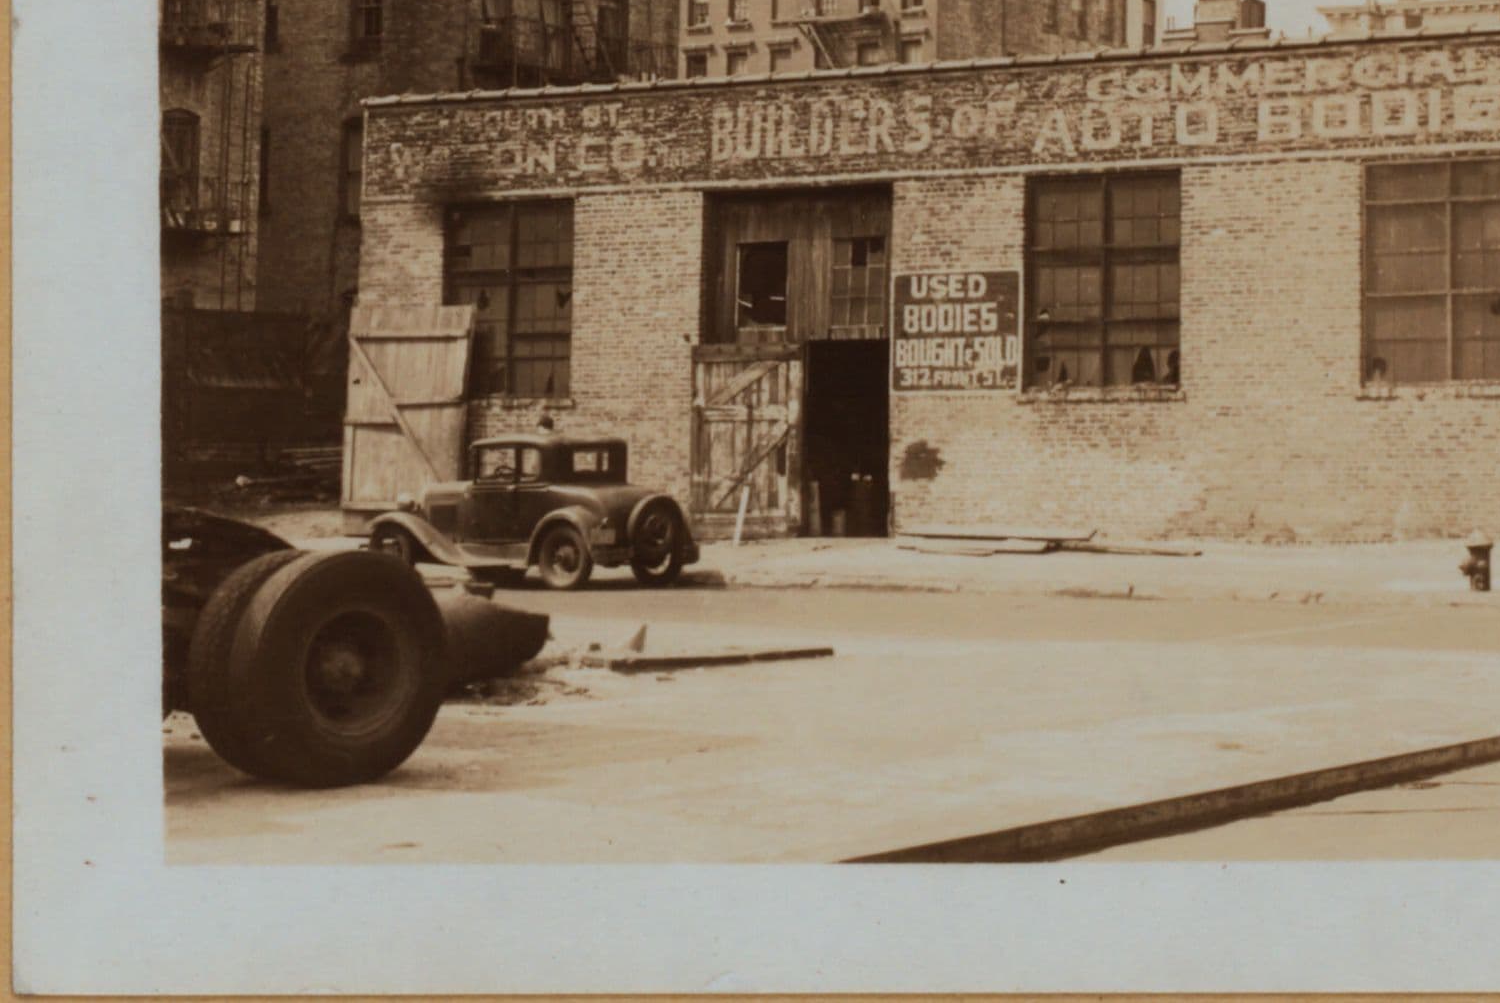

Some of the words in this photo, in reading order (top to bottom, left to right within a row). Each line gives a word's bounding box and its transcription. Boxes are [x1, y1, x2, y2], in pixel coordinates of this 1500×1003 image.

[1086, 48, 1500, 99] COMMERCIAL
[711, 94, 934, 163] BUILDERS
[1030, 98, 1218, 158] AUTO
[910, 273, 988, 299] USED
[903, 301, 999, 334] BODIES
[896, 337, 966, 368] BOUGHT
[974, 334, 1018, 370] SOLD
[900, 368, 931, 387] 312
